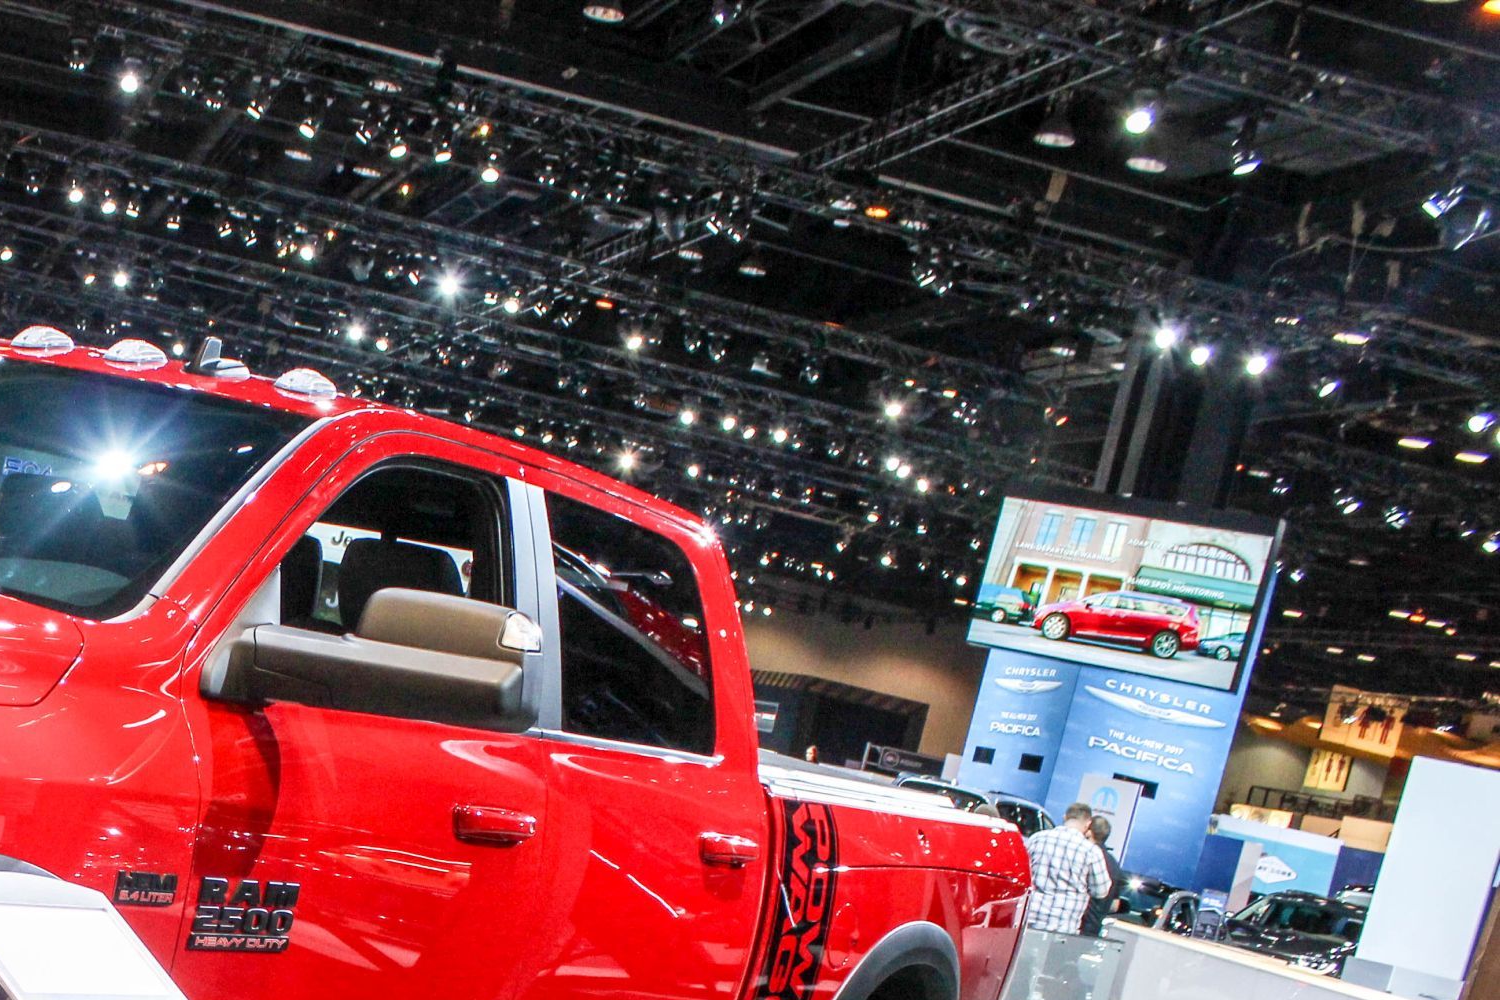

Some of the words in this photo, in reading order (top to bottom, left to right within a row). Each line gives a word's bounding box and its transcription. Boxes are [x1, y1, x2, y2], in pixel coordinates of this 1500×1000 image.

[1150, 579, 1171, 590] SPOT
[1172, 583, 1225, 600] MONITORING
[1005, 667, 1057, 677] CHRYSLER
[1105, 679, 1211, 714] CHRYSLER
[989, 721, 1040, 736] PACIFICA
[1109, 729, 1125, 740] THE
[1125, 734, 1164, 750] ALL-NEW
[1088, 736, 1194, 774] PACIFICA
[140, 890, 174, 903] LITER
[198, 876, 300, 907] RAM
[193, 905, 294, 936] 2500
[195, 935, 244, 948] HEAVY
[246, 937, 286, 949] DUTY
